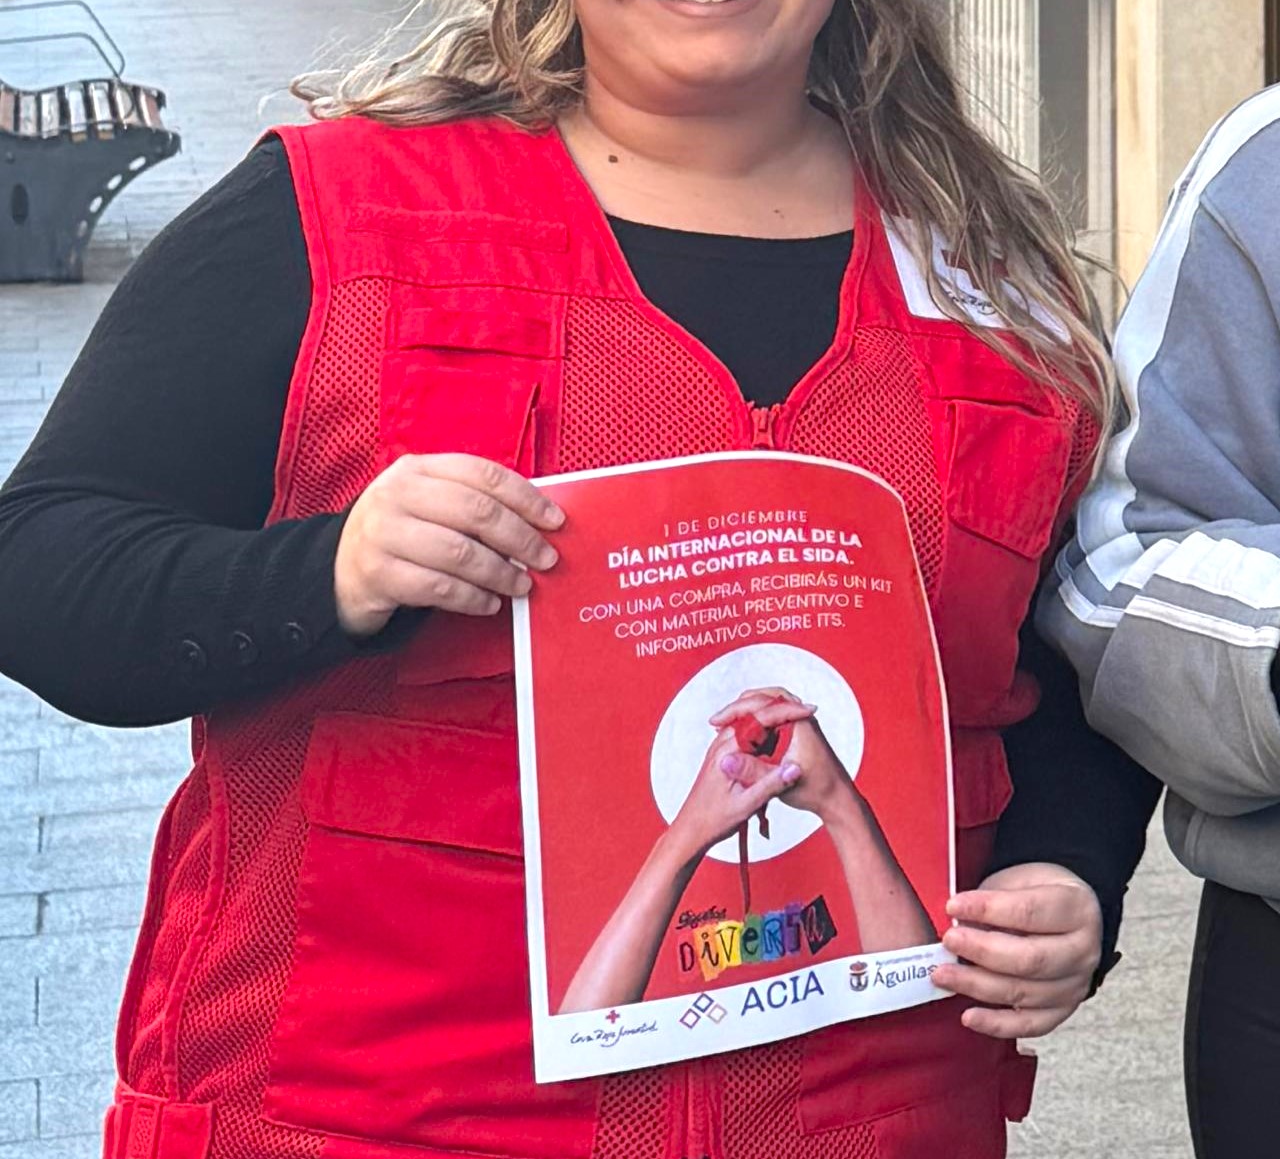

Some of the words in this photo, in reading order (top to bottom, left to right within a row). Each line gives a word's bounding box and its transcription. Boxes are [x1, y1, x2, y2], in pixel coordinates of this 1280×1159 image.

[678, 519, 700, 535] DE
[708, 510, 808, 530] DICIEMBRE
[608, 547, 643, 569] DÍA
[648, 527, 807, 563] INTERNACIONAL
[811, 529, 836, 544] DE
[839, 533, 863, 548] LA
[619, 566, 688, 589] LUCHA
[692, 551, 773, 577] CONTRA
[778, 547, 798, 562] EL
[803, 547, 854, 566] SIDA.
[580, 603, 621, 623] CON
[627, 597, 664, 615] UNA
[669, 581, 746, 607] COMPRA,
[751, 570, 838, 594] RECIBIRÁS
[842, 574, 867, 590] UN
[870, 577, 892, 593] KIT
[615, 620, 658, 639] CON
[662, 605, 741, 631] MATERIAL
[745, 593, 849, 615] PREVENTIVO
[854, 594, 864, 609] E
[636, 623, 751, 658] INFORMATIVO
[755, 614, 812, 635] SOBRE
[816, 612, 846, 629] ITS.
[740, 971, 824, 1016] ACIA
